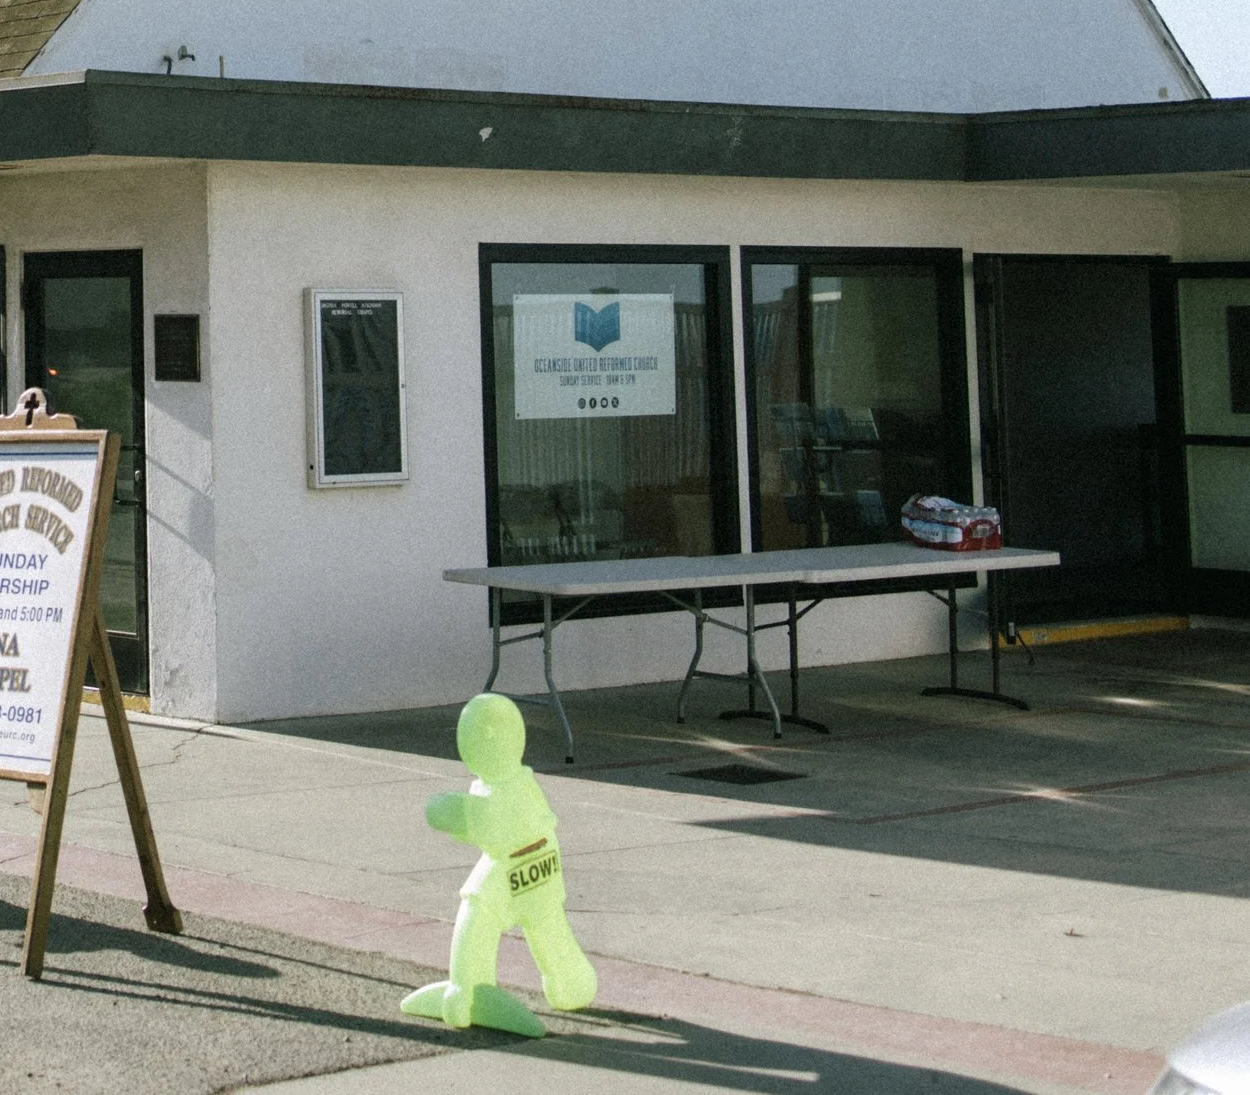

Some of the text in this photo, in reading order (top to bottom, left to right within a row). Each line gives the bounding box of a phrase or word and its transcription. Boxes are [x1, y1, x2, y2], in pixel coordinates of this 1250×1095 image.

[534, 356, 658, 373] OCEANSIDE UNITED REFORMED CHURCH
[559, 375, 580, 386] SUNDAY
[581, 375, 602, 386] SERVICE
[21, 466, 83, 513] REFORMED
[24, 504, 74, 555] SERVICE
[20, 606, 44, 622] 5:00
[45, 607, 63, 623] PM
[510, 855, 558, 891] SLOW!
